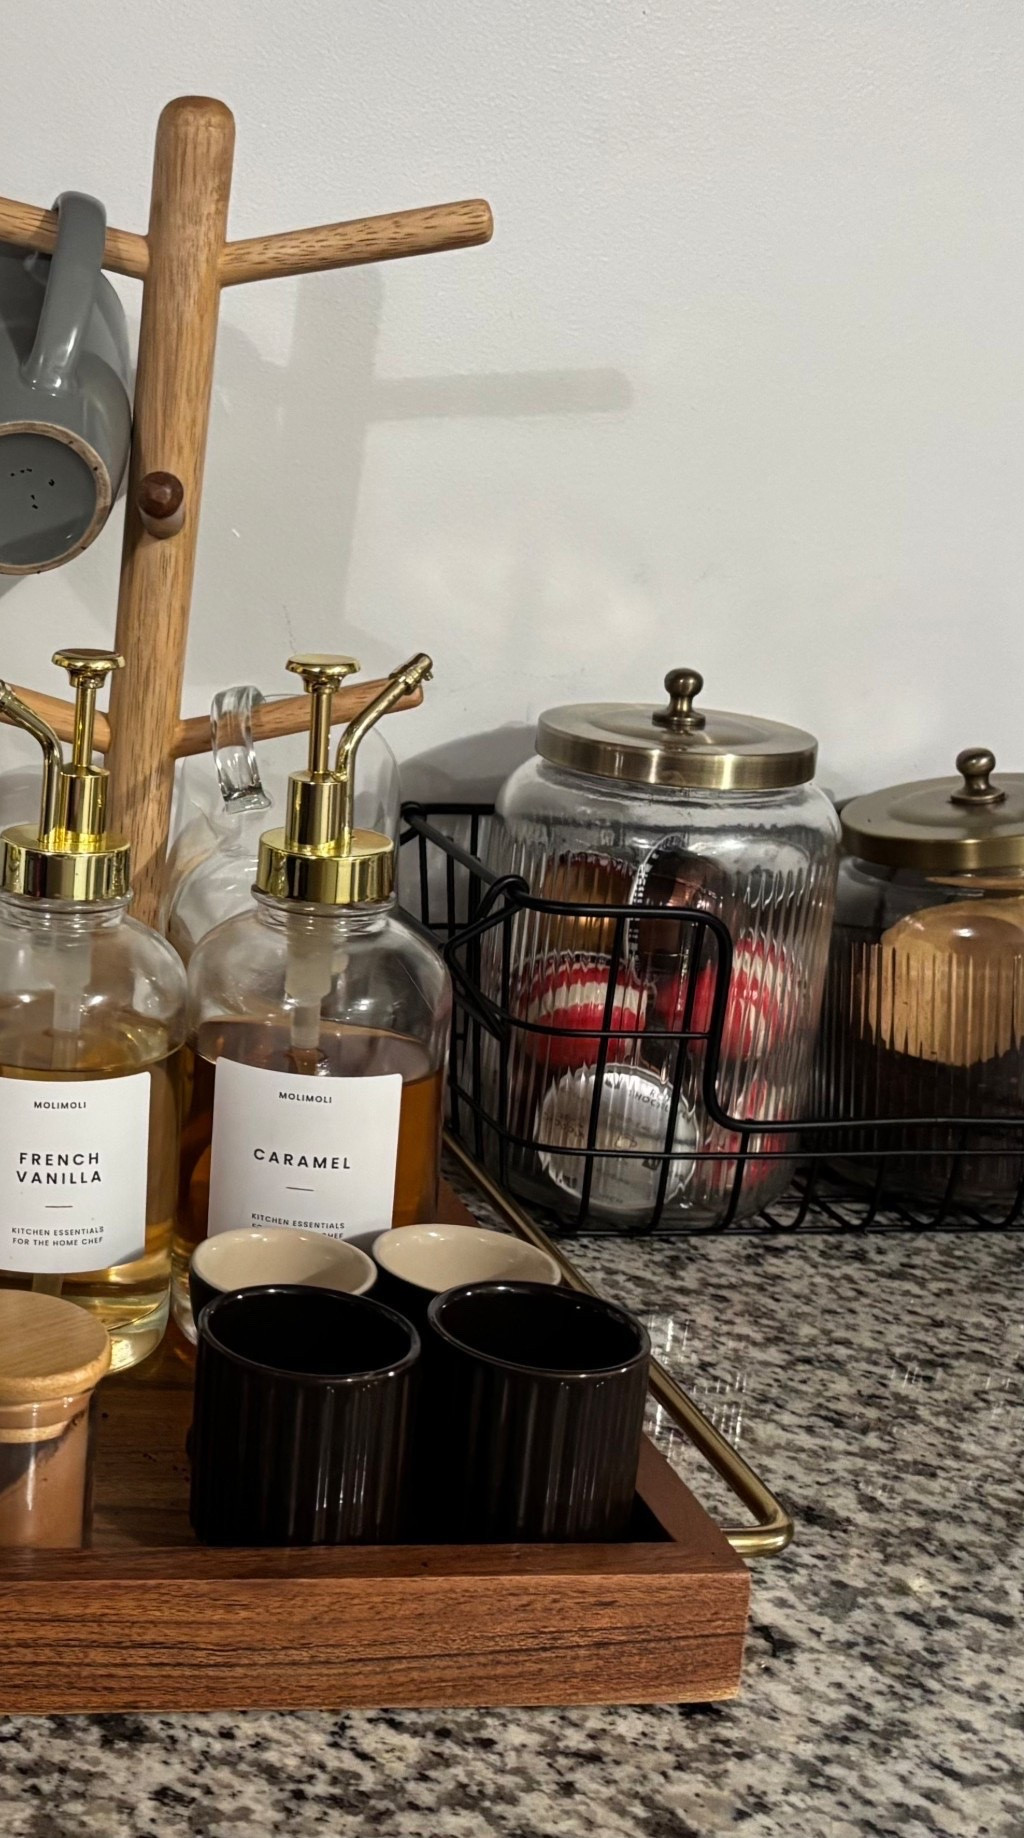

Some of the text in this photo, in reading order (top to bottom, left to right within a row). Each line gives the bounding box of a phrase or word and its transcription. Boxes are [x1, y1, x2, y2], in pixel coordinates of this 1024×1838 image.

[278, 1091, 332, 1104] MOLIMOLI
[33, 1101, 87, 1109] MOLIMOLI
[19, 1152, 99, 1166] FRENCH
[253, 1148, 351, 1170] CARAMEL
[16, 1170, 102, 1185] VANILLA
[251, 1213, 345, 1229] KITCHEN ESSENTIALS
[11, 1226, 105, 1236] KITCHEN ESSENTIALS
[12, 1236, 103, 1247] FOR THE HOME CHEF
